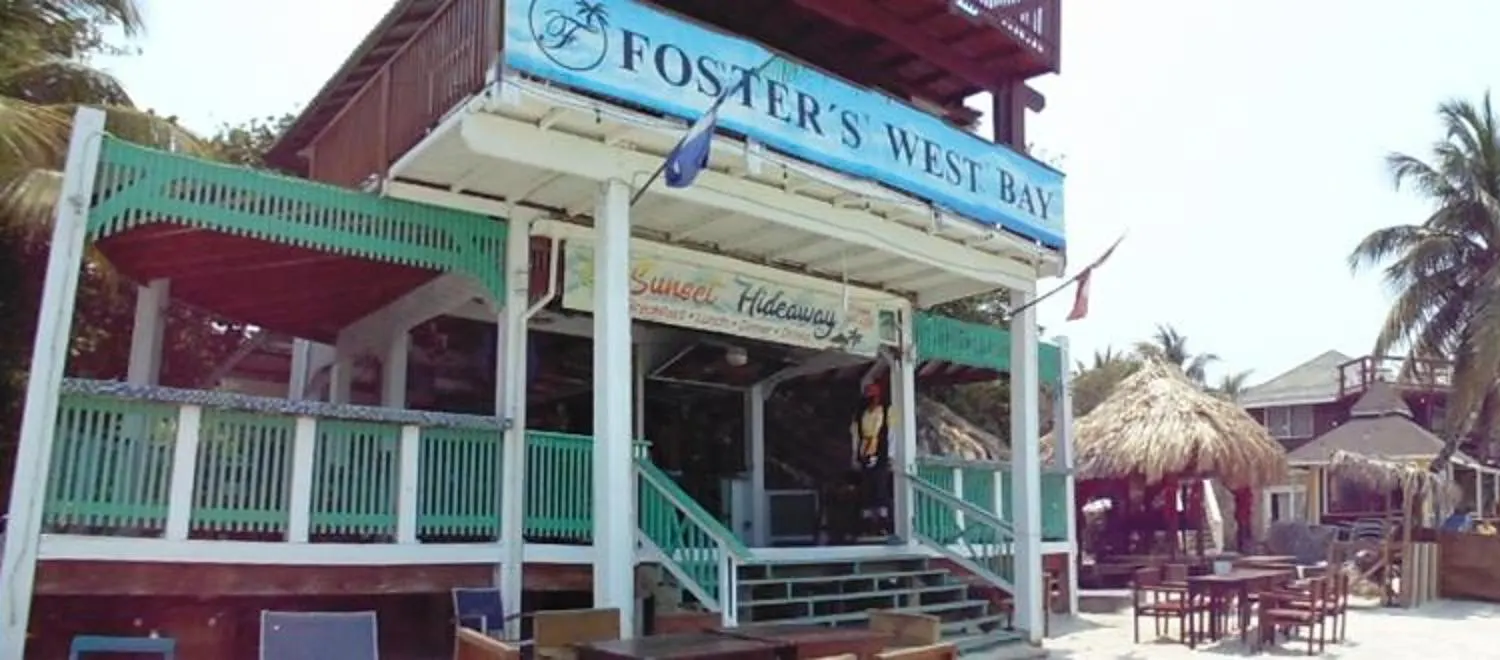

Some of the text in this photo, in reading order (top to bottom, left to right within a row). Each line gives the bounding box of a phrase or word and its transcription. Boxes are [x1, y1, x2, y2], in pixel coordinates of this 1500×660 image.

[883, 121, 984, 194] WEST
[996, 166, 1055, 220] BAY
[734, 273, 836, 339] Hideaway
